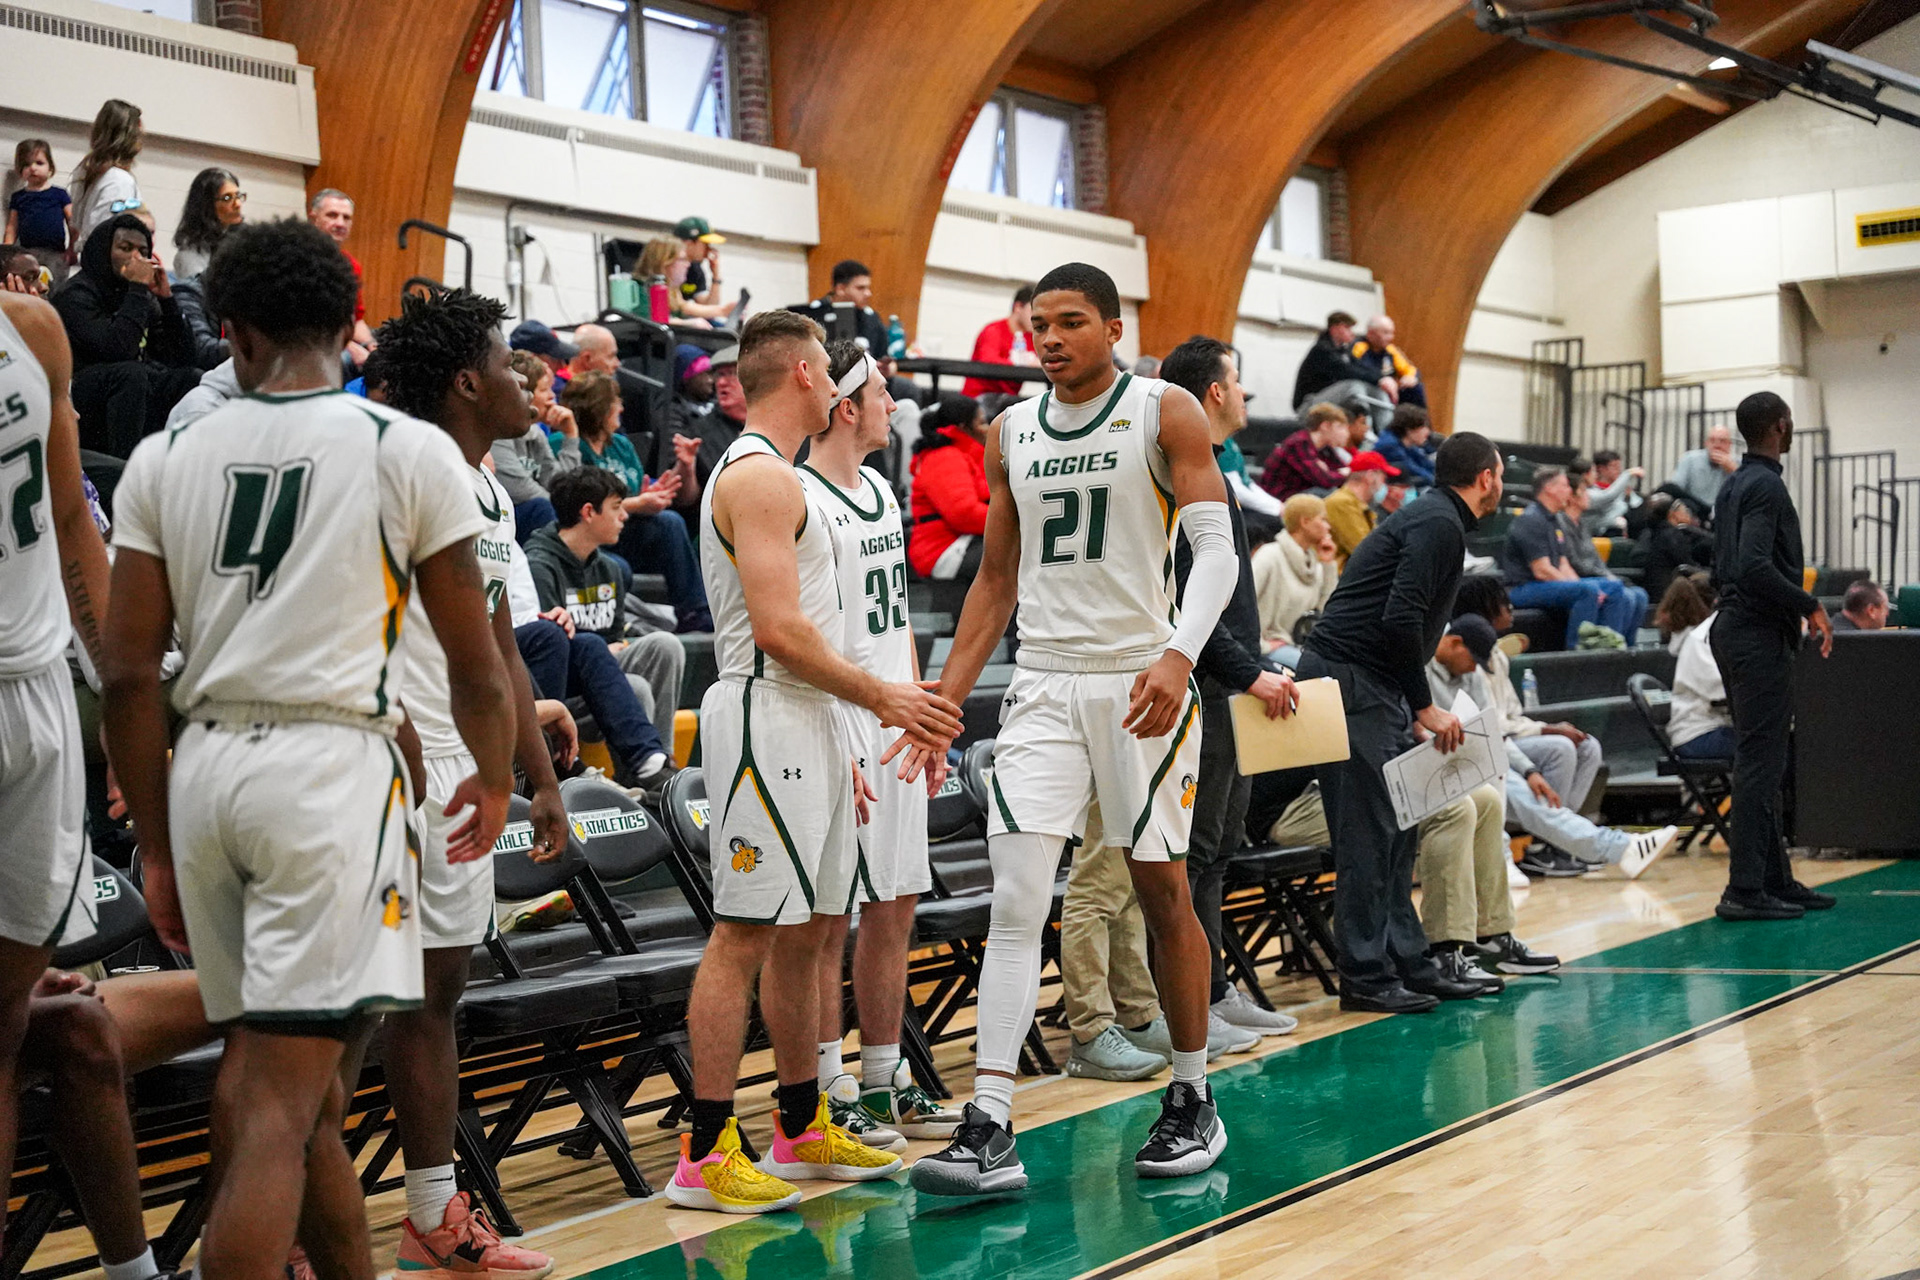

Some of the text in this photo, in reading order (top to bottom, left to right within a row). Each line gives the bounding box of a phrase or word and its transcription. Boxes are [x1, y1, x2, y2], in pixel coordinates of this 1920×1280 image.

[1109, 424, 1131, 432] MAC
[1025, 450, 1119, 480] AGGIES
[211, 458, 314, 604] 4
[1039, 484, 1111, 567] 21
[859, 531, 903, 559] AGGIES
[865, 560, 907, 638] 33
[586, 812, 646, 834] ATHLETICS
